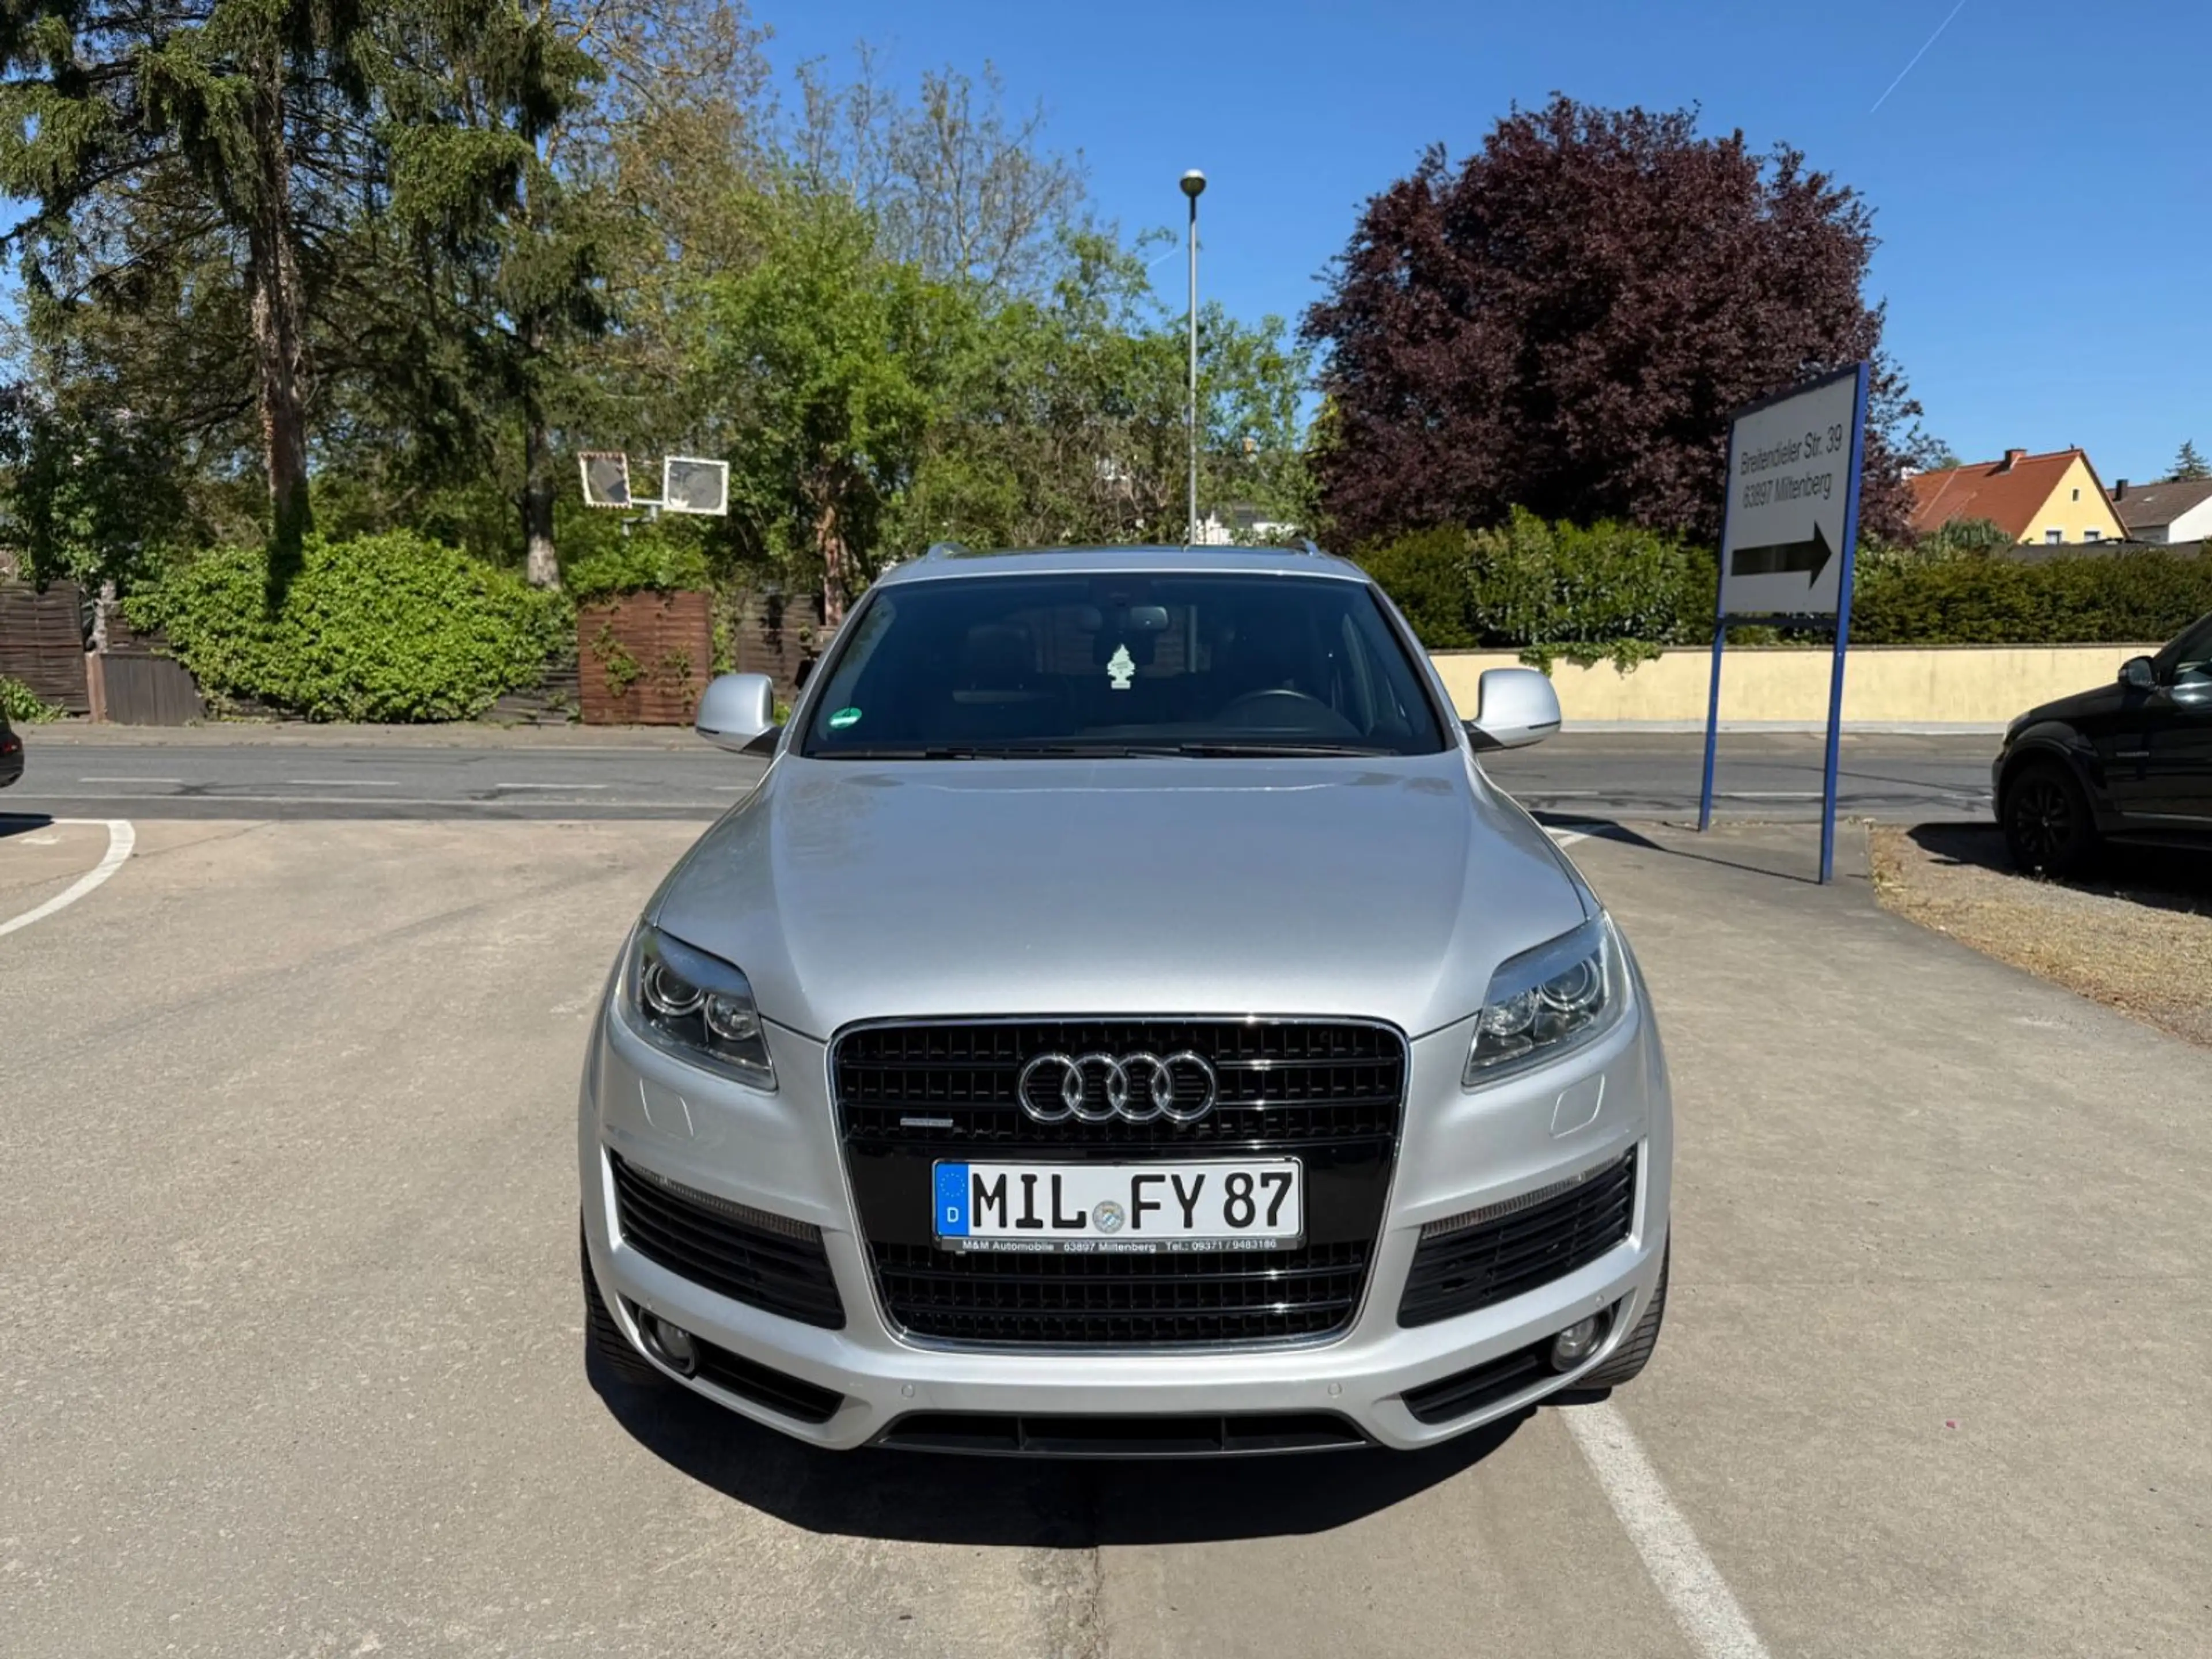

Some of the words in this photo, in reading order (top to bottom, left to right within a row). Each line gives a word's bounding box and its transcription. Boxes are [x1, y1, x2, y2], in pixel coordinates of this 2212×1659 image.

[1740, 438, 1802, 475] Breitendieler
[1804, 432, 1823, 459] Str.
[1826, 423, 1842, 453] 39
[1743, 479, 1773, 509] 63897
[1774, 471, 1832, 500] Miltenberg
[946, 1207, 959, 1222] D
[972, 1173, 1086, 1229] MIL
[1131, 1174, 1206, 1229] FY
[1223, 1172, 1293, 1229] 87
[963, 1240, 989, 1249] M&M
[993, 1240, 1054, 1251] Automobile
[1165, 1241, 1188, 1251] Tel.:
